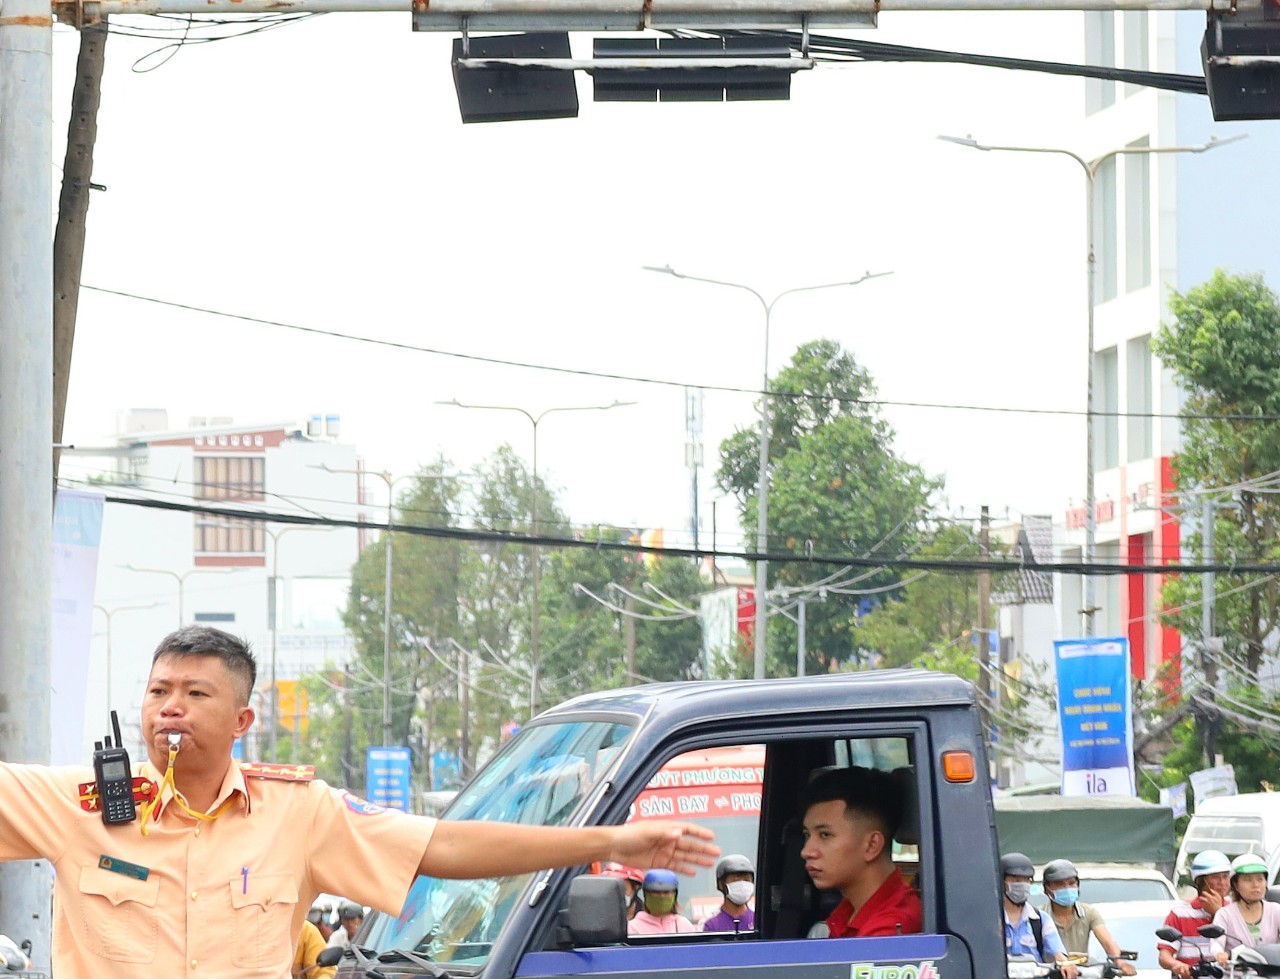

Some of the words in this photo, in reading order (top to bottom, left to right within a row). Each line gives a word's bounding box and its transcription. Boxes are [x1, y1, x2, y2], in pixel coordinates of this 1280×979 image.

[1086, 773, 1108, 793] ila
[640, 795, 673, 816] SÂN
[677, 793, 709, 813] BAY
